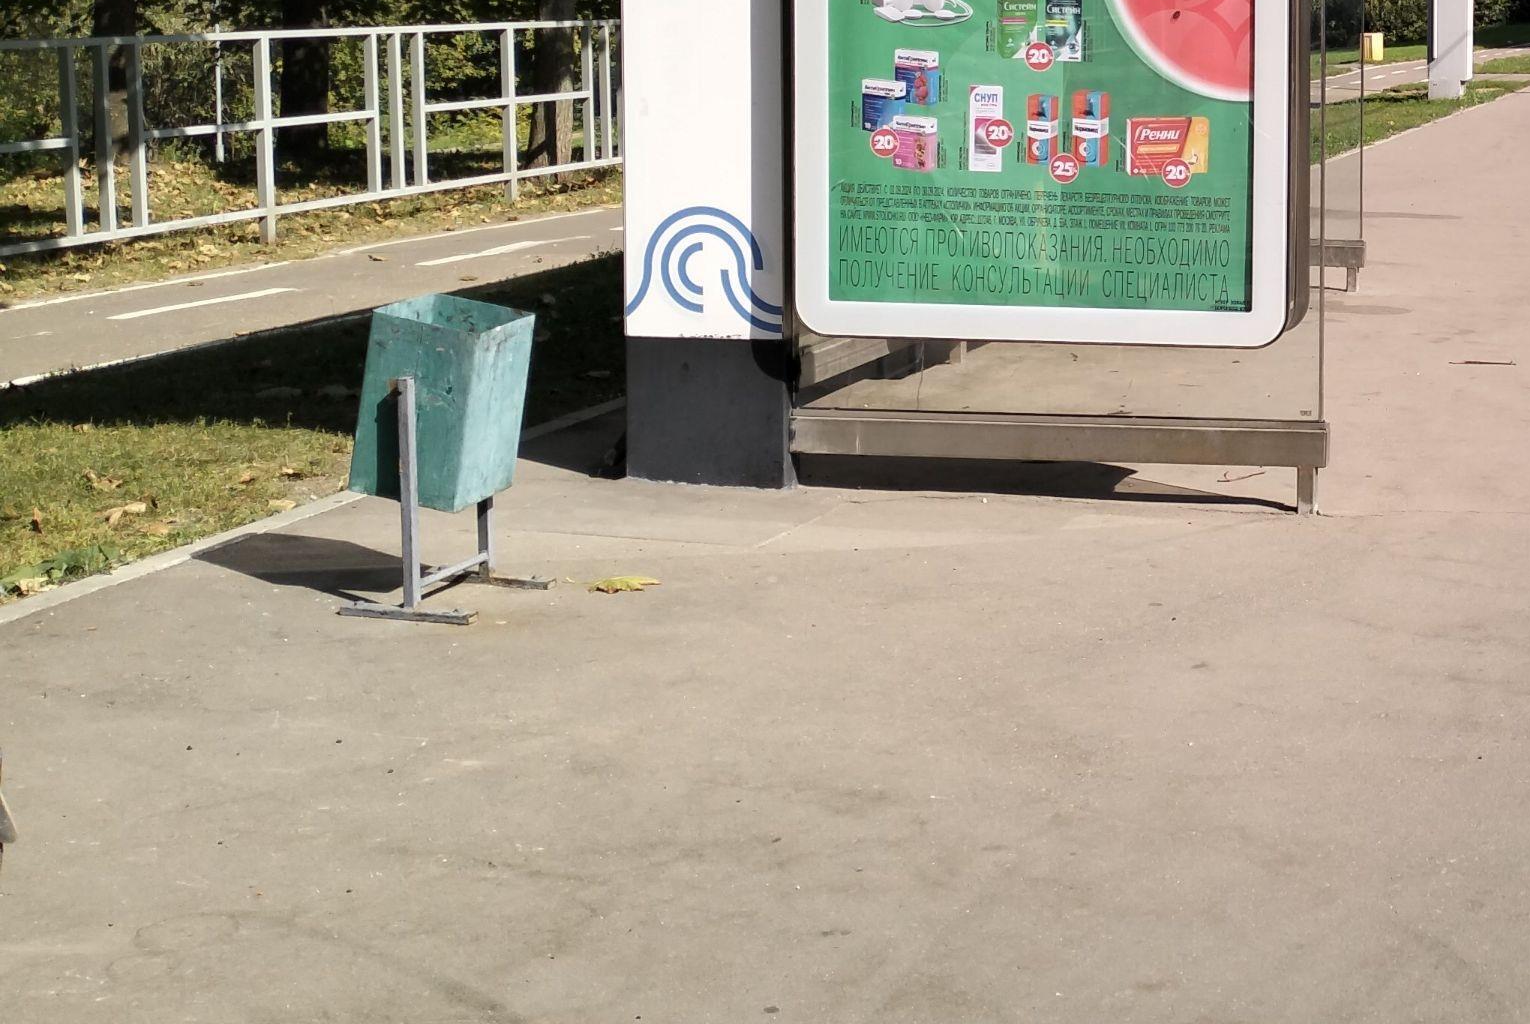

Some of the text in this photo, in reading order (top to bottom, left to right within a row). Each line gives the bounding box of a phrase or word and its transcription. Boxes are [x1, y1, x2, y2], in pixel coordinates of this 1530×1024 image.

[974, 92, 998, 103] СНУП
[1139, 128, 1181, 141] Ренни
[839, 226, 1230, 271] ИМЕЮТСЯ ПРОТИВОПОКАЗАНИЯ. НЕОБХОДИМО
[839, 258, 1230, 303] ПОЛУЧЕНИЕ КОНСУЛЬТАЦИИ СПЕЦИАЛИСТА
